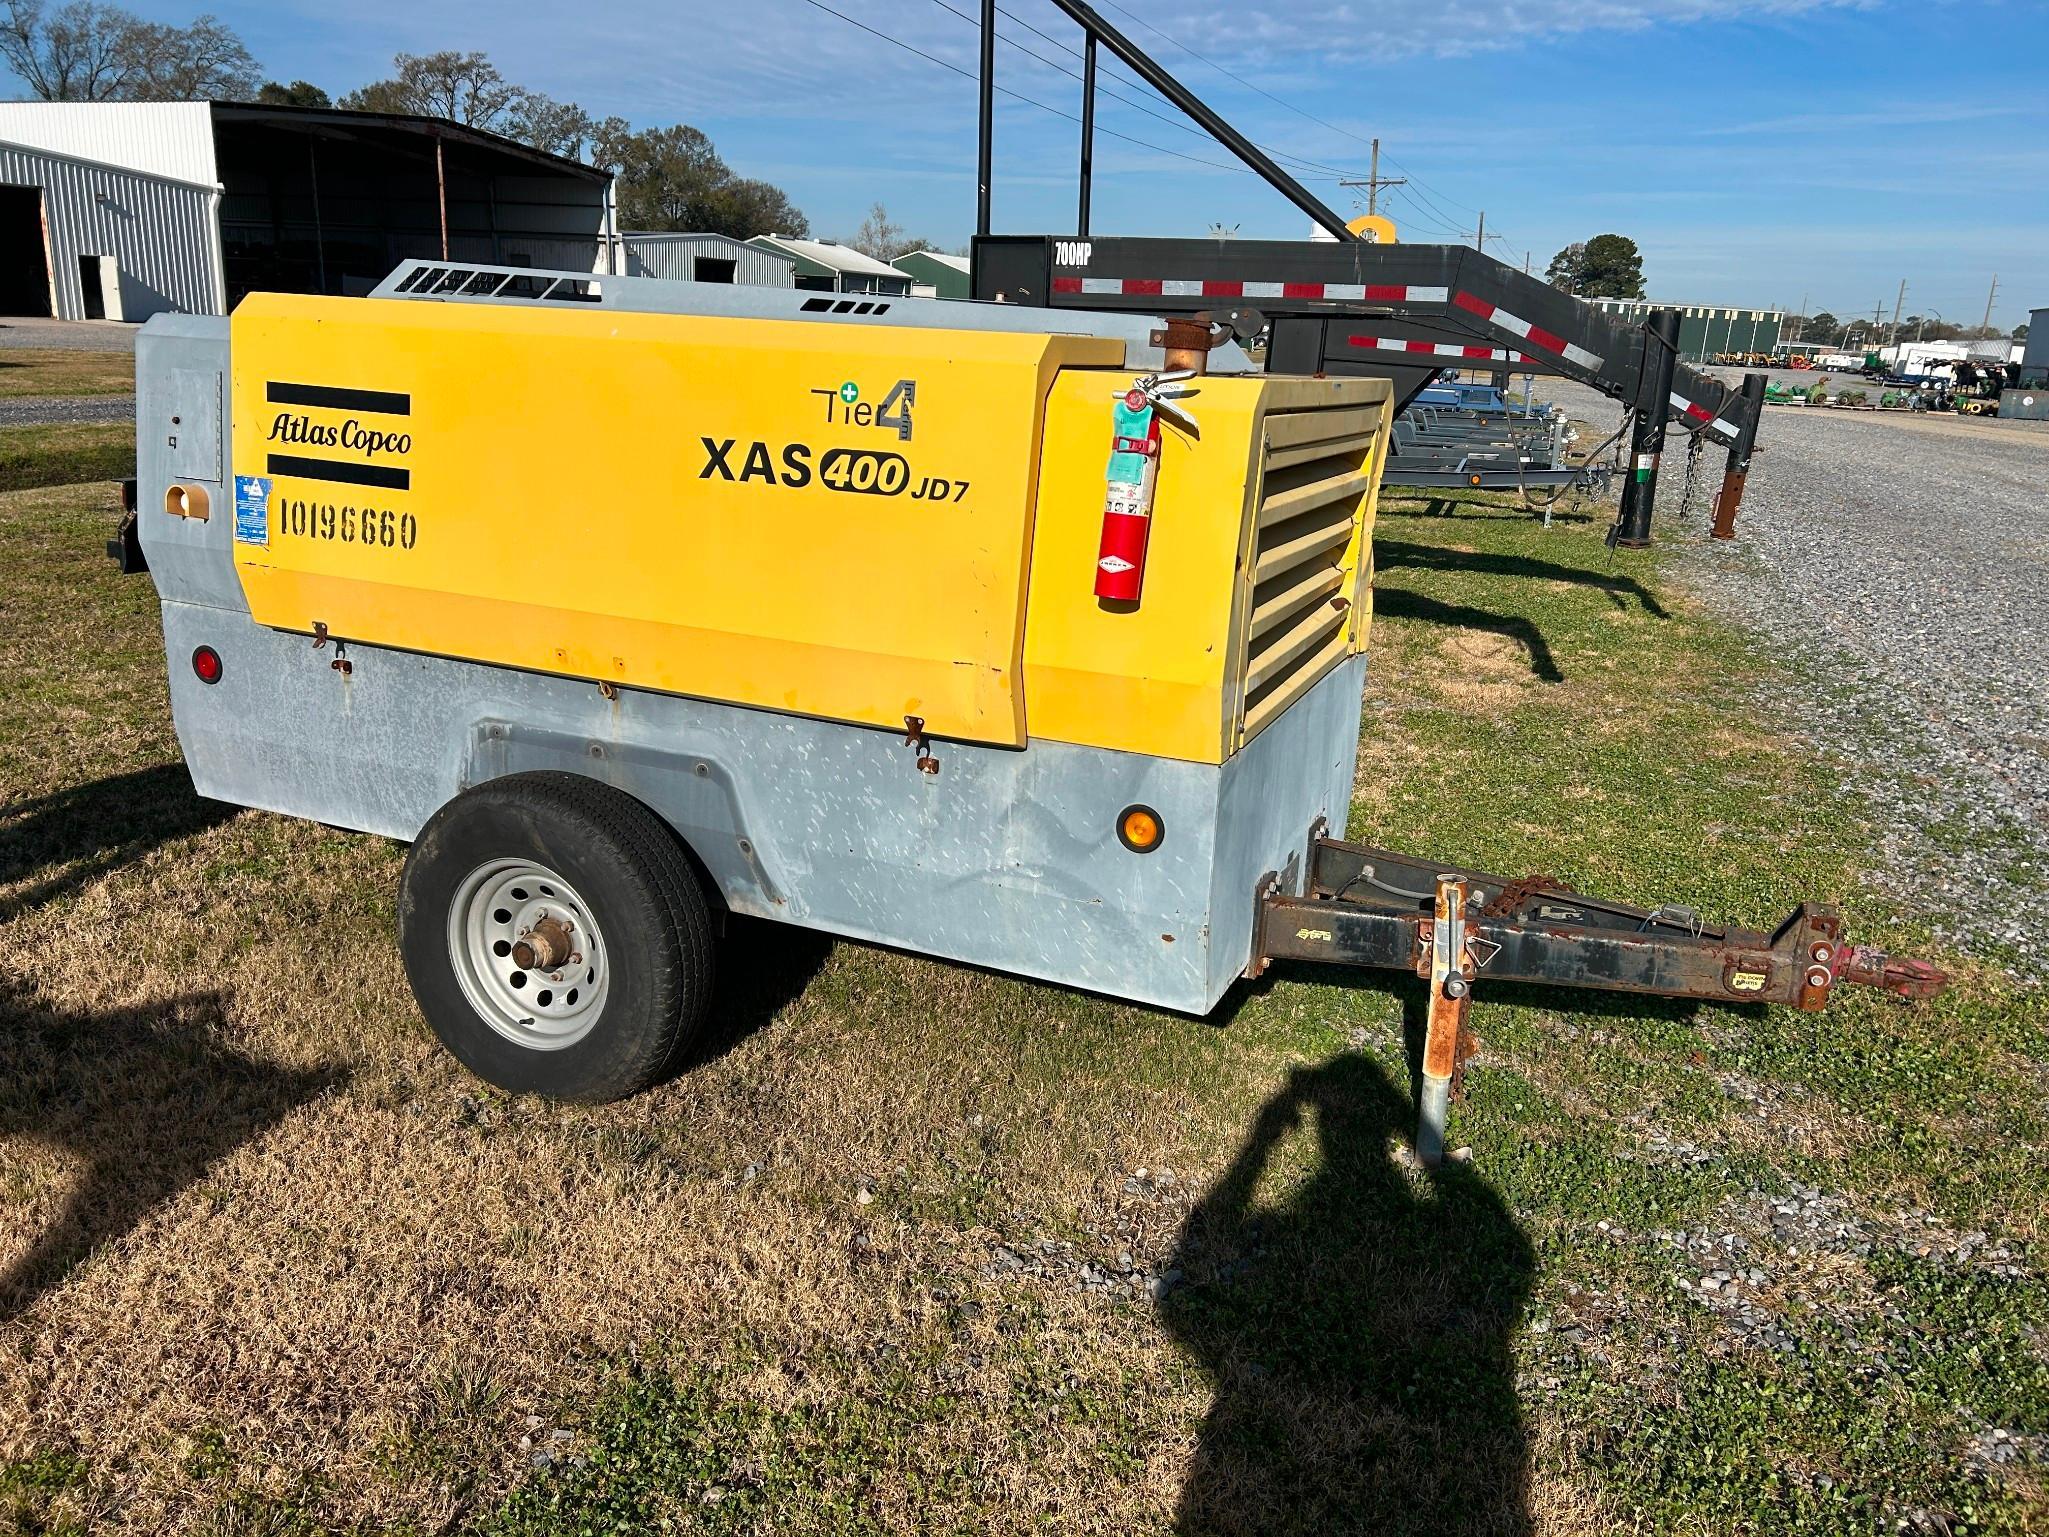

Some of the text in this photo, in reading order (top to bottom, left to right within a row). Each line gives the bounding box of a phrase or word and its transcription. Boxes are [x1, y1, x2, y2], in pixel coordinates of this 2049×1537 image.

[1055, 241, 1092, 266] 700HP
[267, 413, 412, 457] Atlas Copco
[698, 436, 970, 504] XAS 400 JD7
[280, 498, 417, 550] 10196660
